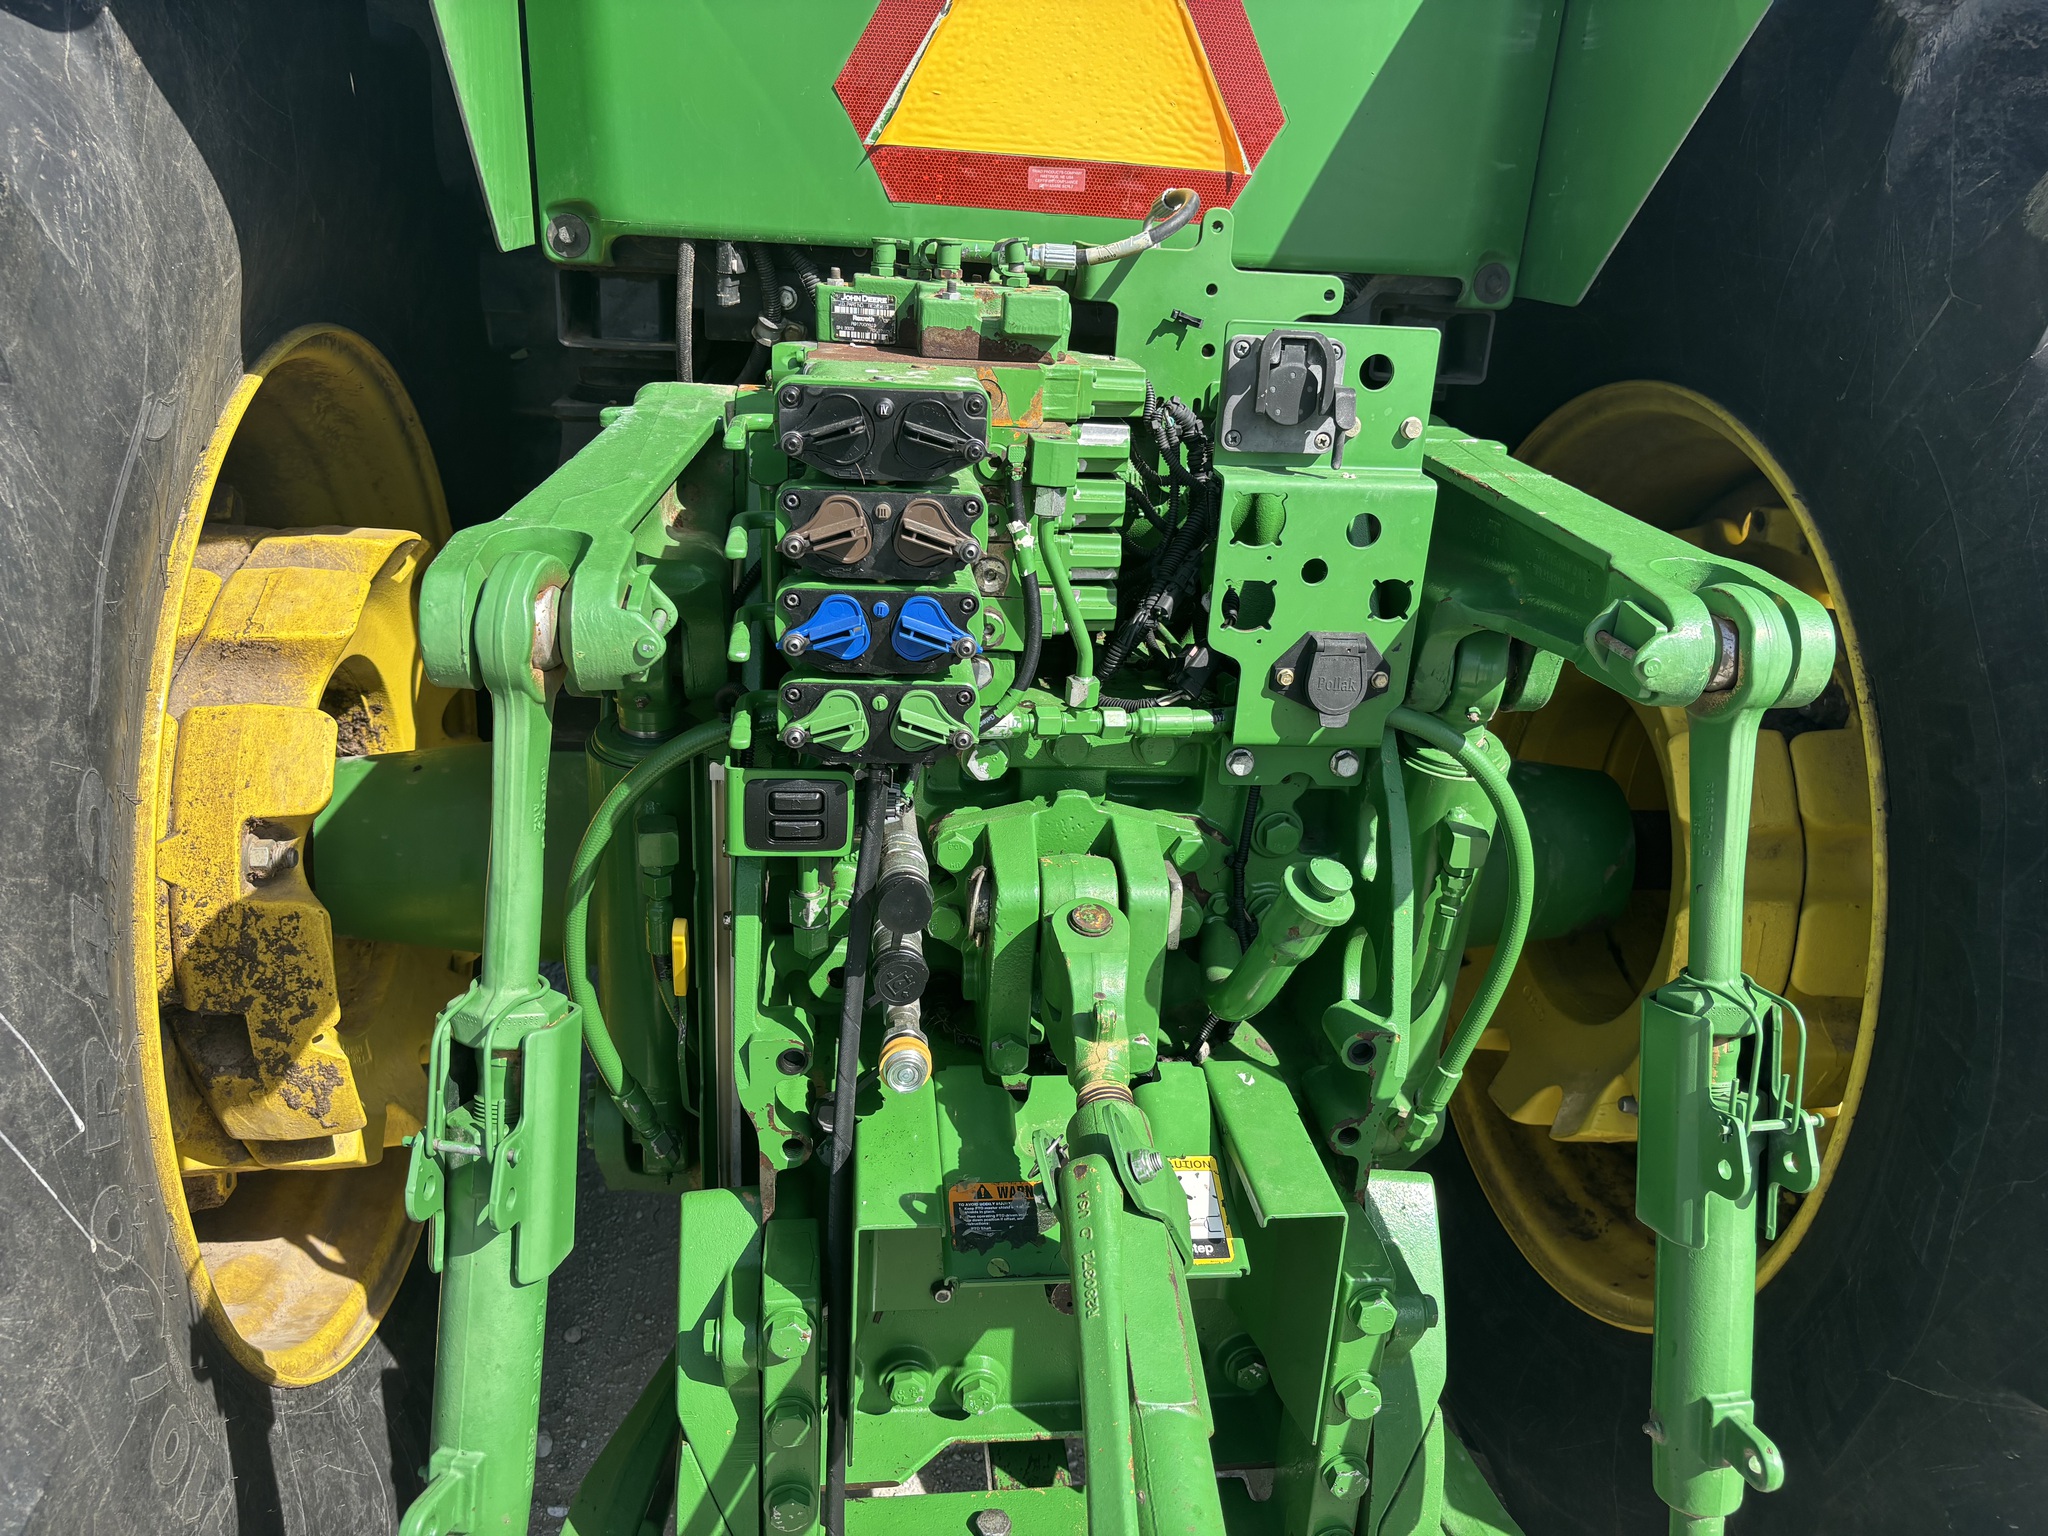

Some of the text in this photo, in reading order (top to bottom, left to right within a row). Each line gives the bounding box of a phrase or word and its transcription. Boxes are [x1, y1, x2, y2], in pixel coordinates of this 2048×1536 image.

[840, 293, 888, 304] JOHN DEERE
[877, 508, 887, 517] III
[876, 606, 884, 616] II
[1317, 676, 1357, 692] Pollak
[1076, 1190, 1091, 1220] USA
